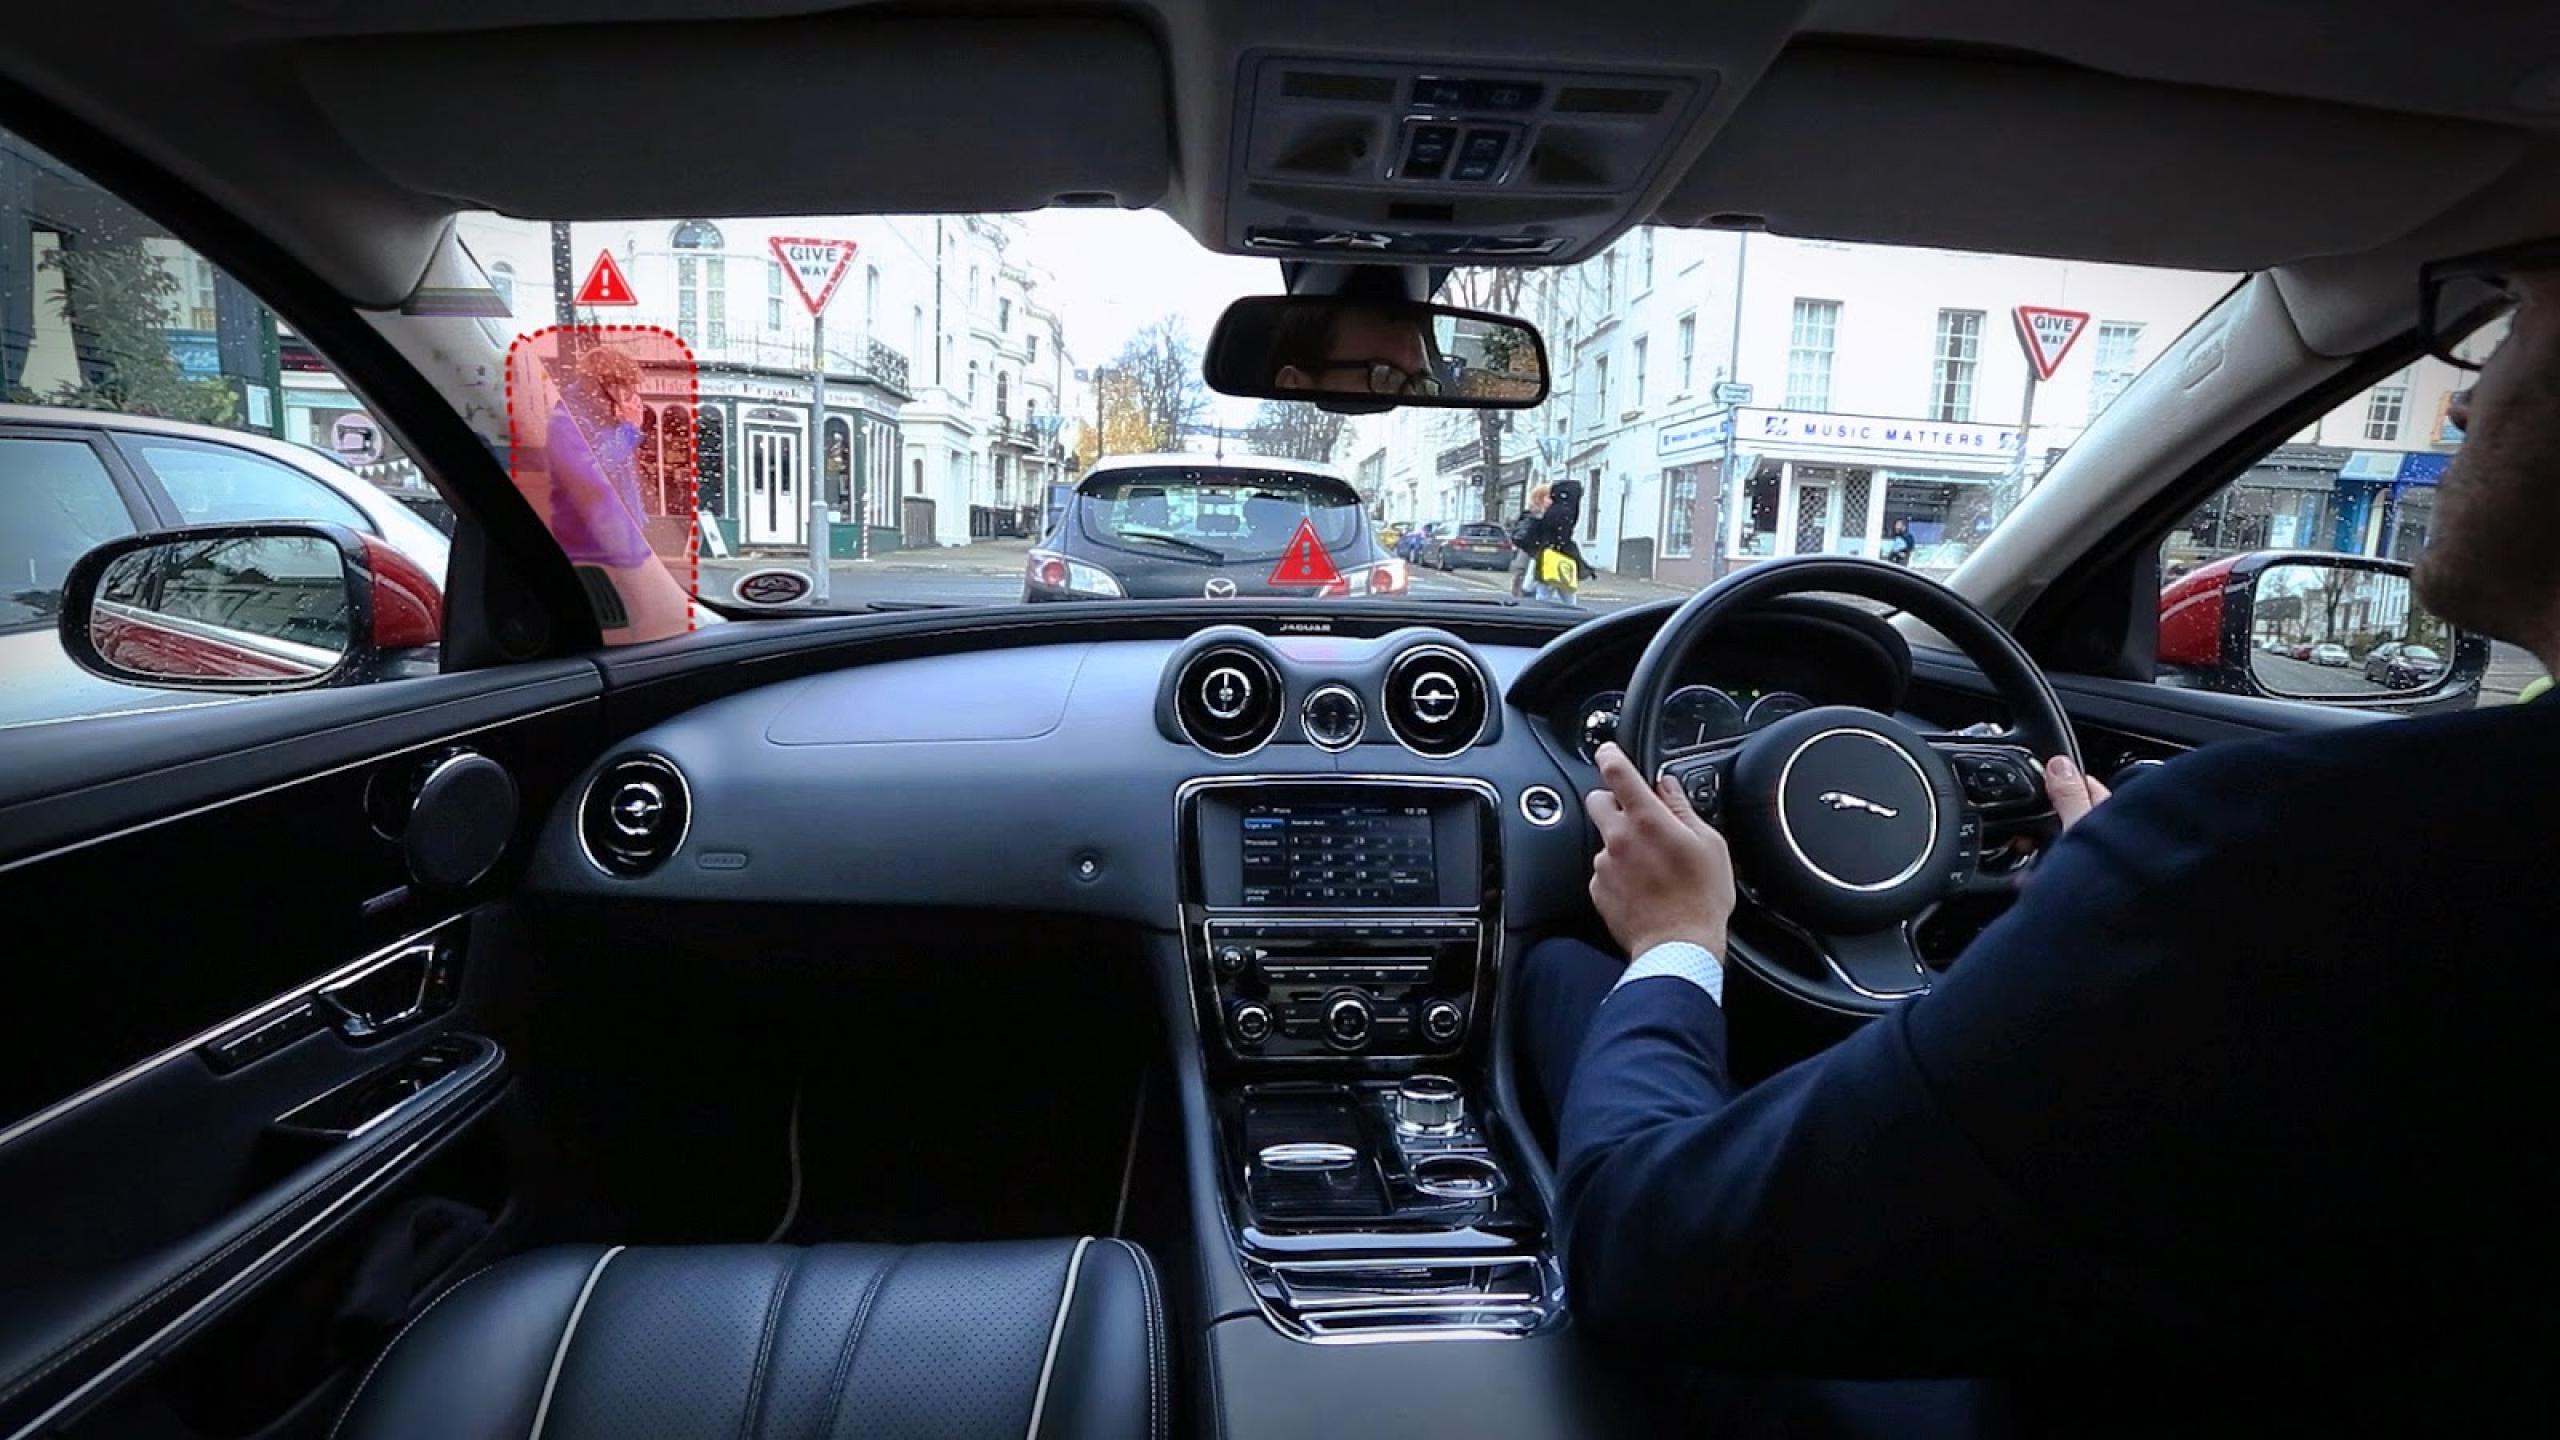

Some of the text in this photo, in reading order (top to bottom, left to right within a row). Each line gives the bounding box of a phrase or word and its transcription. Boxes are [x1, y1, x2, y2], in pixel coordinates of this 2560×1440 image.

[789, 245, 837, 263] GIVE
[799, 266, 829, 277] WAY
[2034, 314, 2073, 333] GIVE
[2041, 334, 2066, 345] WAY
[1804, 422, 1984, 446] MUSIC MATTERS
[1279, 623, 1331, 632] JAGUAR
